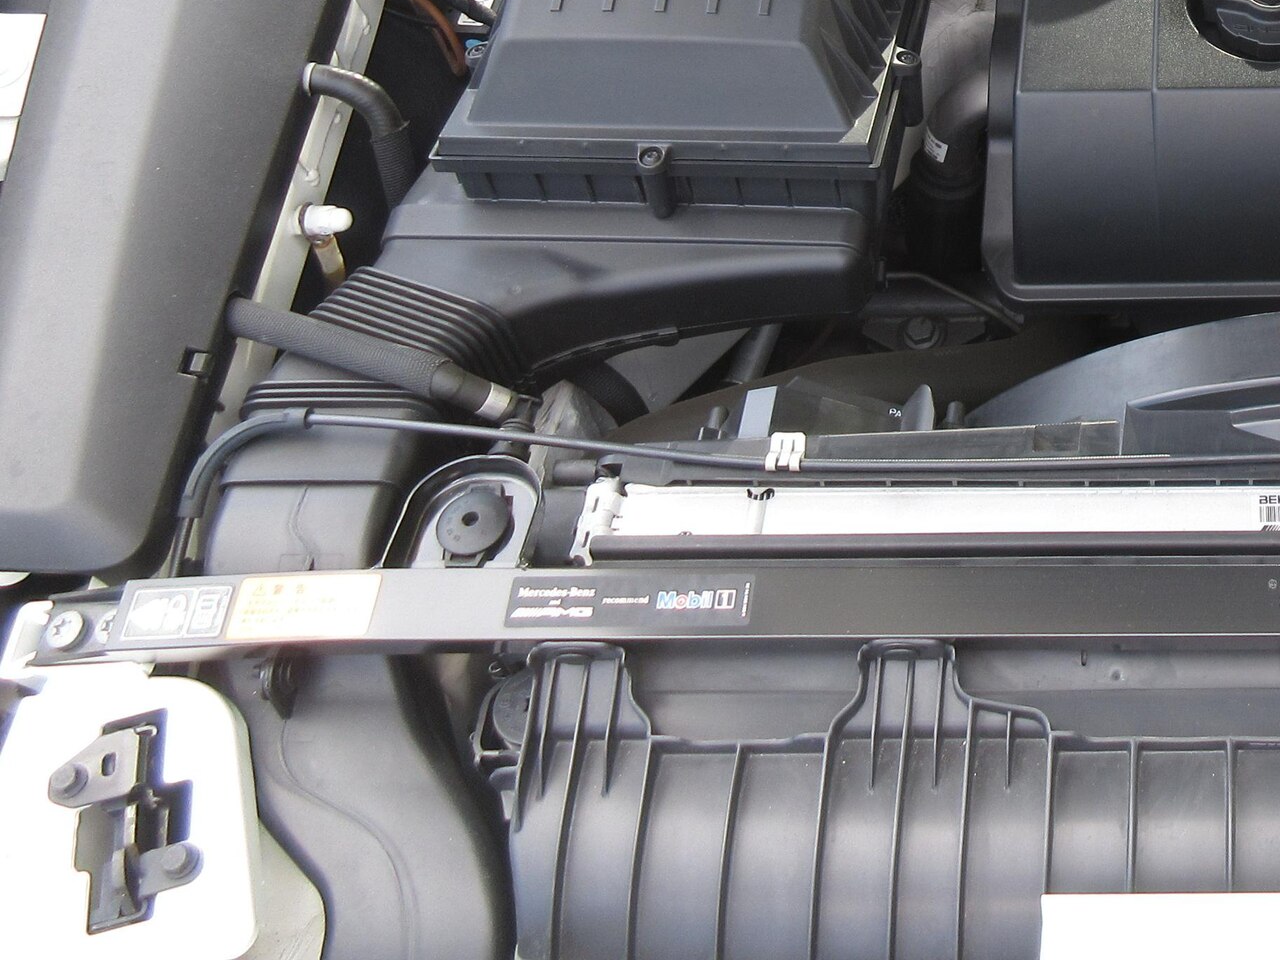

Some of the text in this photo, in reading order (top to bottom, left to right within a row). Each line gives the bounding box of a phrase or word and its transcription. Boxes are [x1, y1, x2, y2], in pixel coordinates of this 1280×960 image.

[517, 586, 597, 598] Mercedes-Benz
[601, 595, 650, 605] recommend
[655, 590, 714, 610] Mobil
